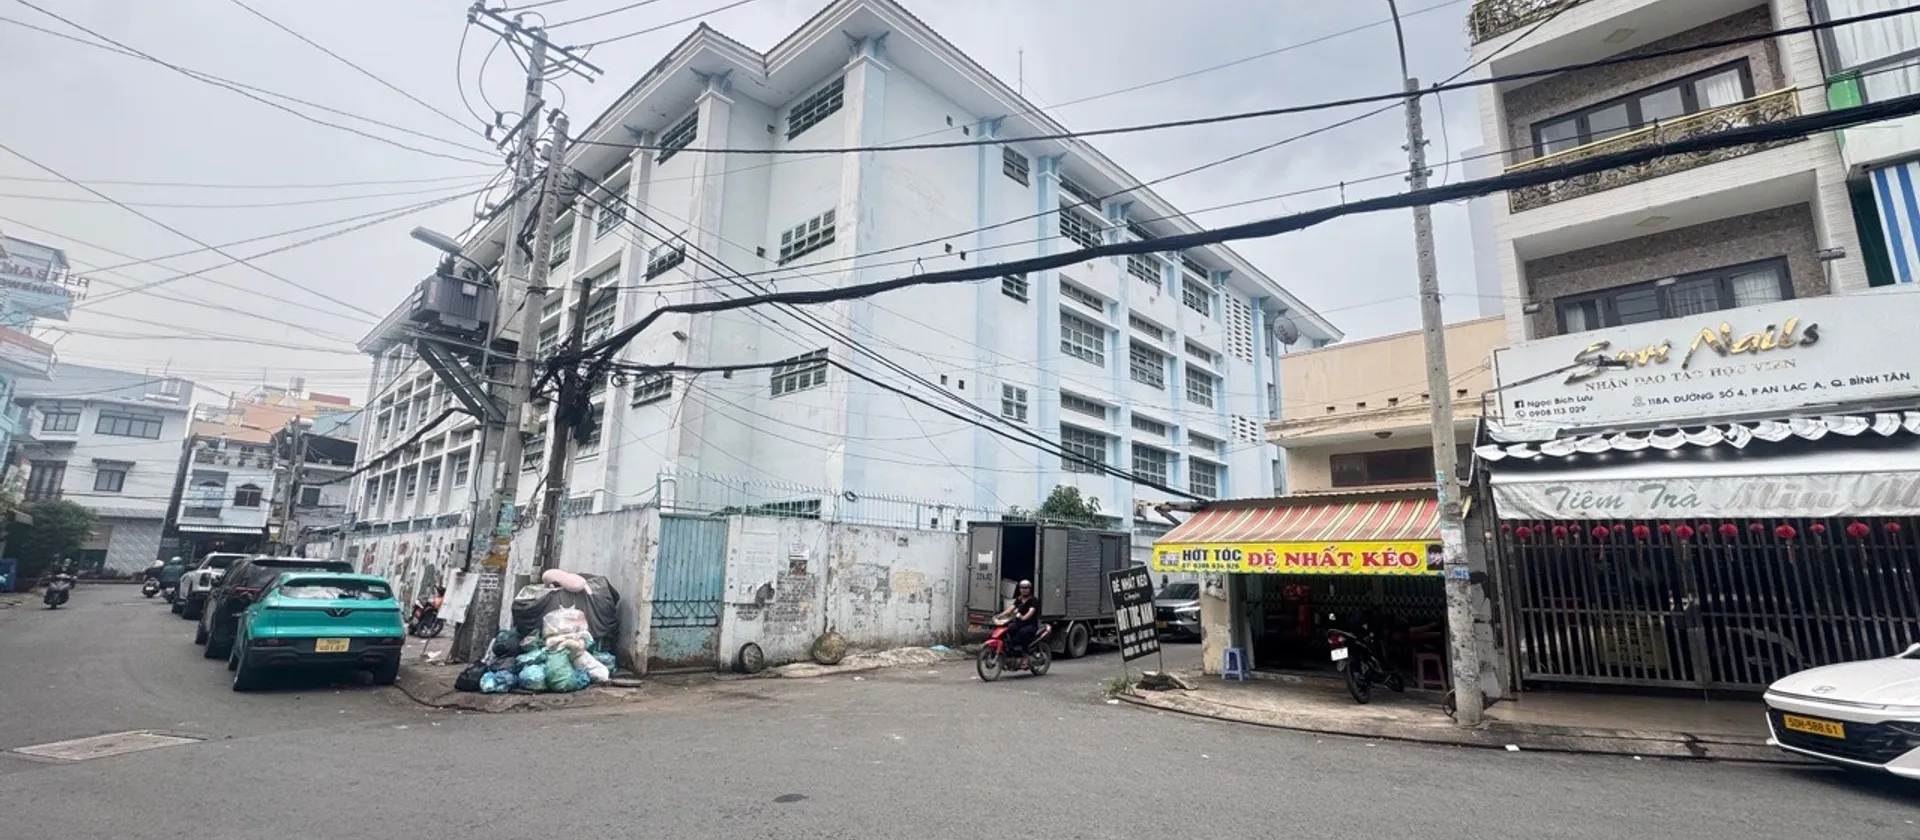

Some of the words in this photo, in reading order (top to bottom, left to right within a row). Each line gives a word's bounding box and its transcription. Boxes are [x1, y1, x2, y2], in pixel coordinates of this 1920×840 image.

[1681, 316, 1820, 369] Nails
[1638, 483, 1703, 510] Trà
[1214, 545, 1242, 561] TÓC
[1247, 548, 1278, 570] ĐỆ
[1284, 545, 1354, 567] NHẤT
[1361, 547, 1419, 567] KÉO
